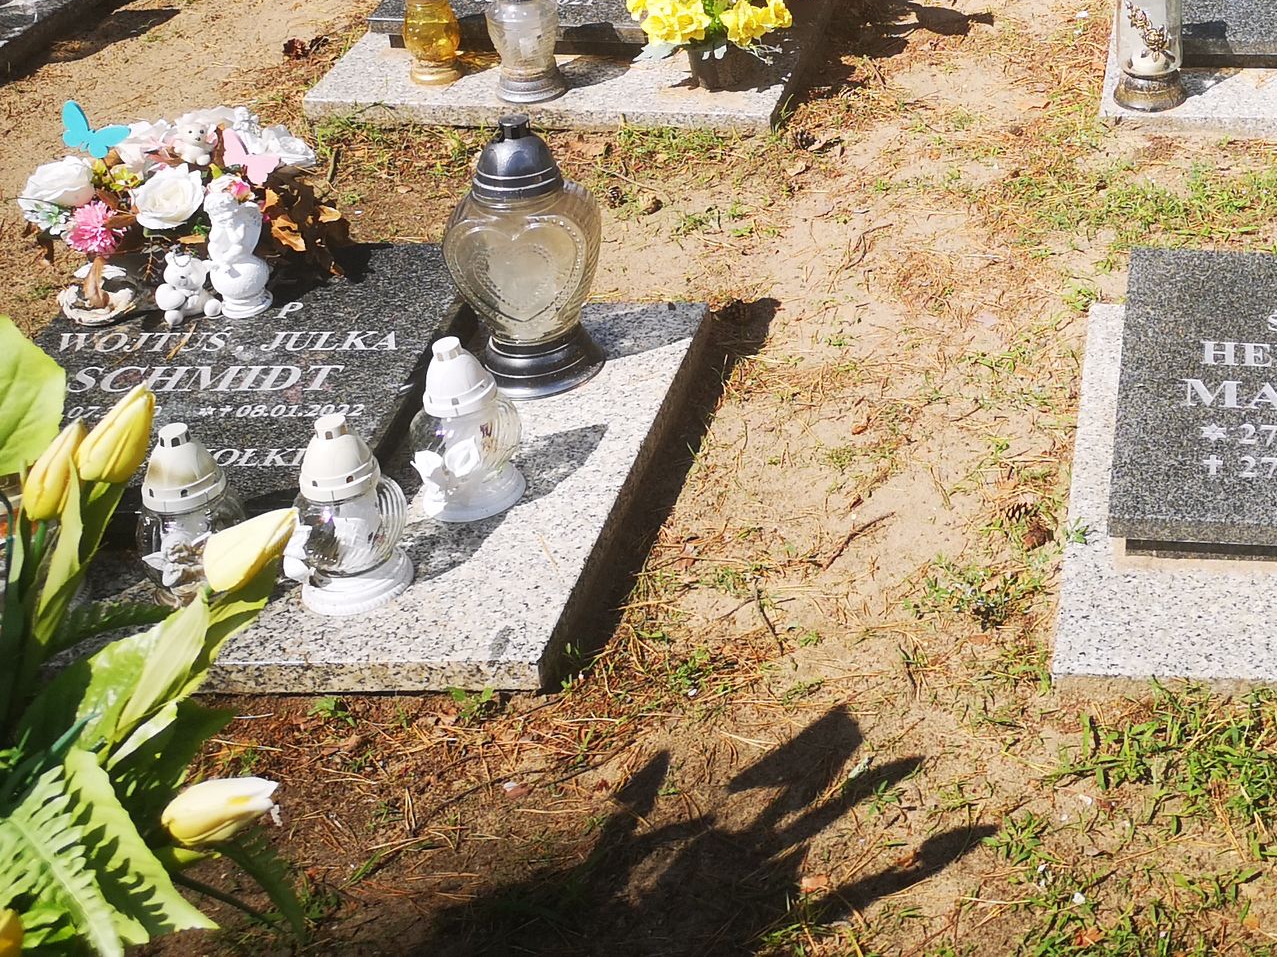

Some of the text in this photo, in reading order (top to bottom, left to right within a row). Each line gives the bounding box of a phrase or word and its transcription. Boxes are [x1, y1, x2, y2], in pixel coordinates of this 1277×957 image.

[273, 301, 304, 320] P
[260, 330, 399, 352] JULKA
[68, 364, 346, 393] SCHMIDT
[236, 404, 365, 417] 08.01.2022
